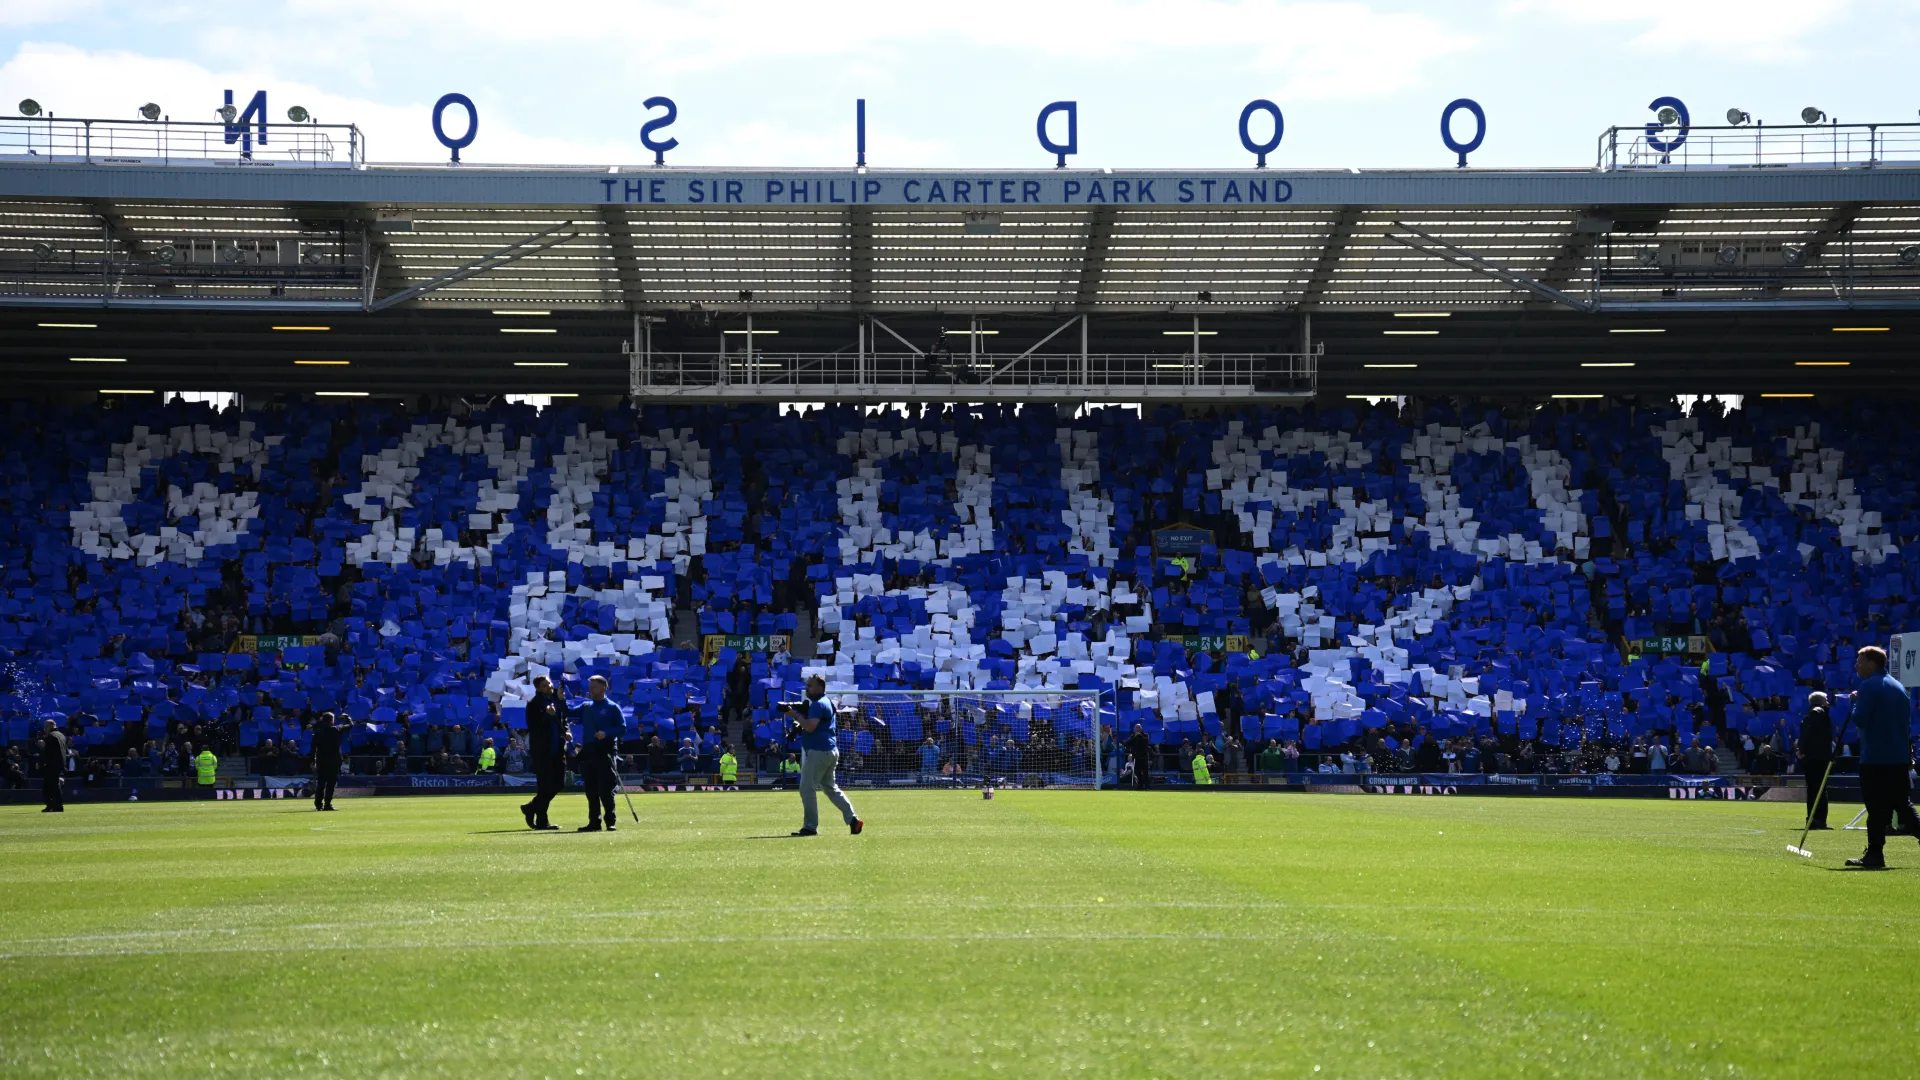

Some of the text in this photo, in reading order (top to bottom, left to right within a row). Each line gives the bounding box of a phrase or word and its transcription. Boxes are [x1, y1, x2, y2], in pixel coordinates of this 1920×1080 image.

[599, 179, 1293, 203] THE SIR PHILIP CARTER PARK STAND
[1645, 640, 1659, 648] Exit
[411, 776, 448, 788] Bristol
[1368, 776, 1418, 785] CROSTON BLUES
